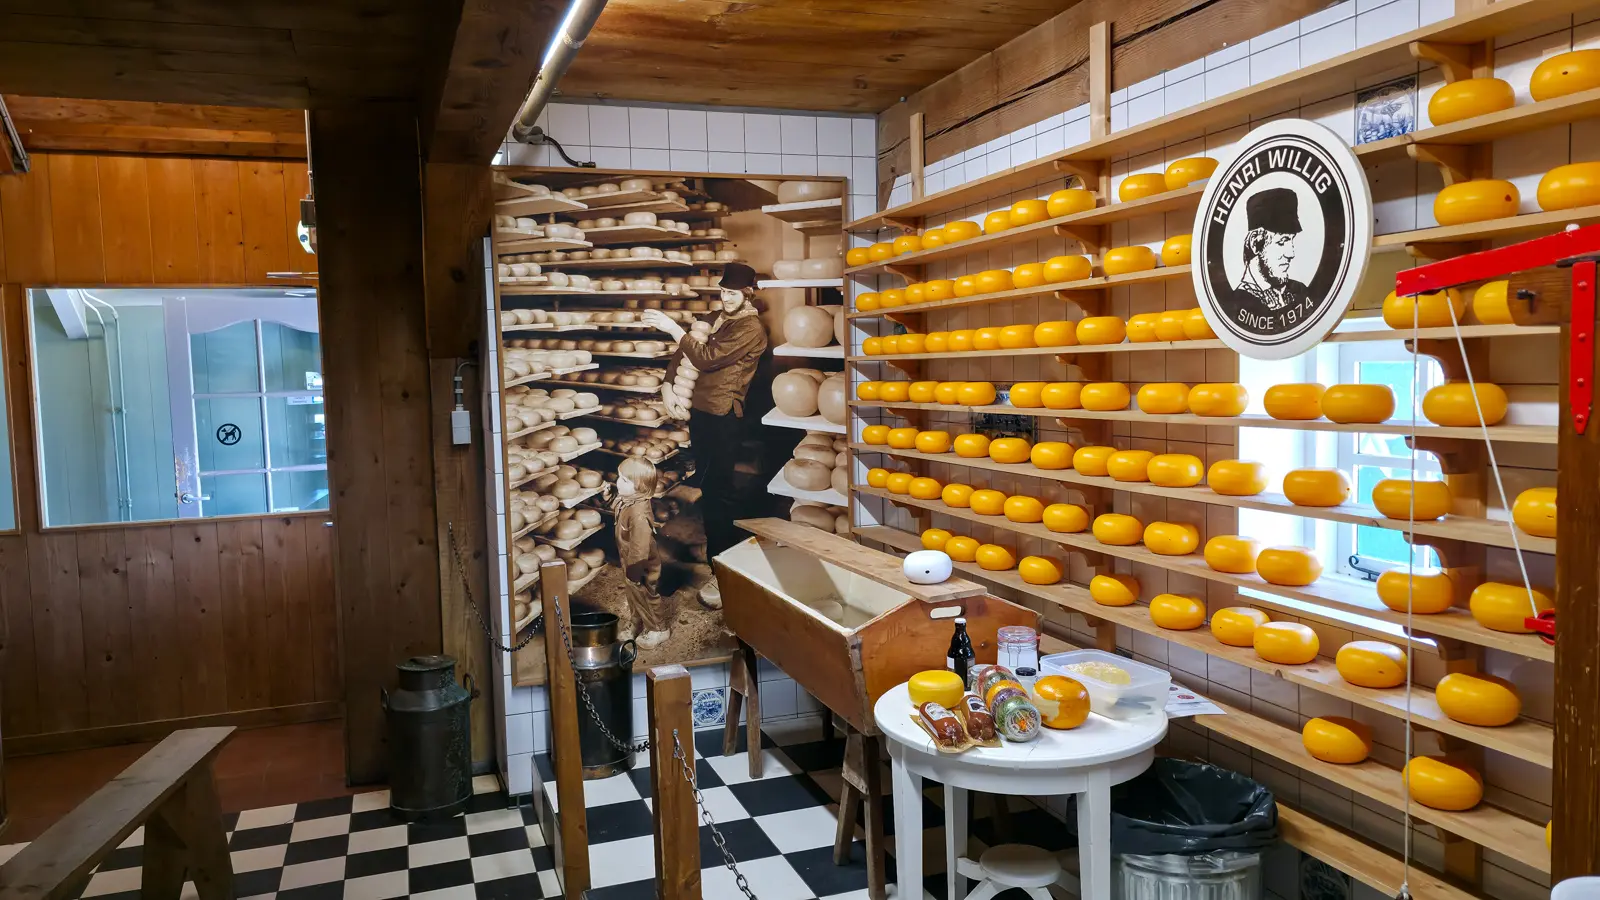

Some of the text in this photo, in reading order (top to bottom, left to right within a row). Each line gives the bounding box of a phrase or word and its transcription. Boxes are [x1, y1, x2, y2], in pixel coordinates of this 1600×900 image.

[1213, 148, 1332, 225] HENRI WILLIG
[1237, 296, 1314, 330] SINCE 1974
